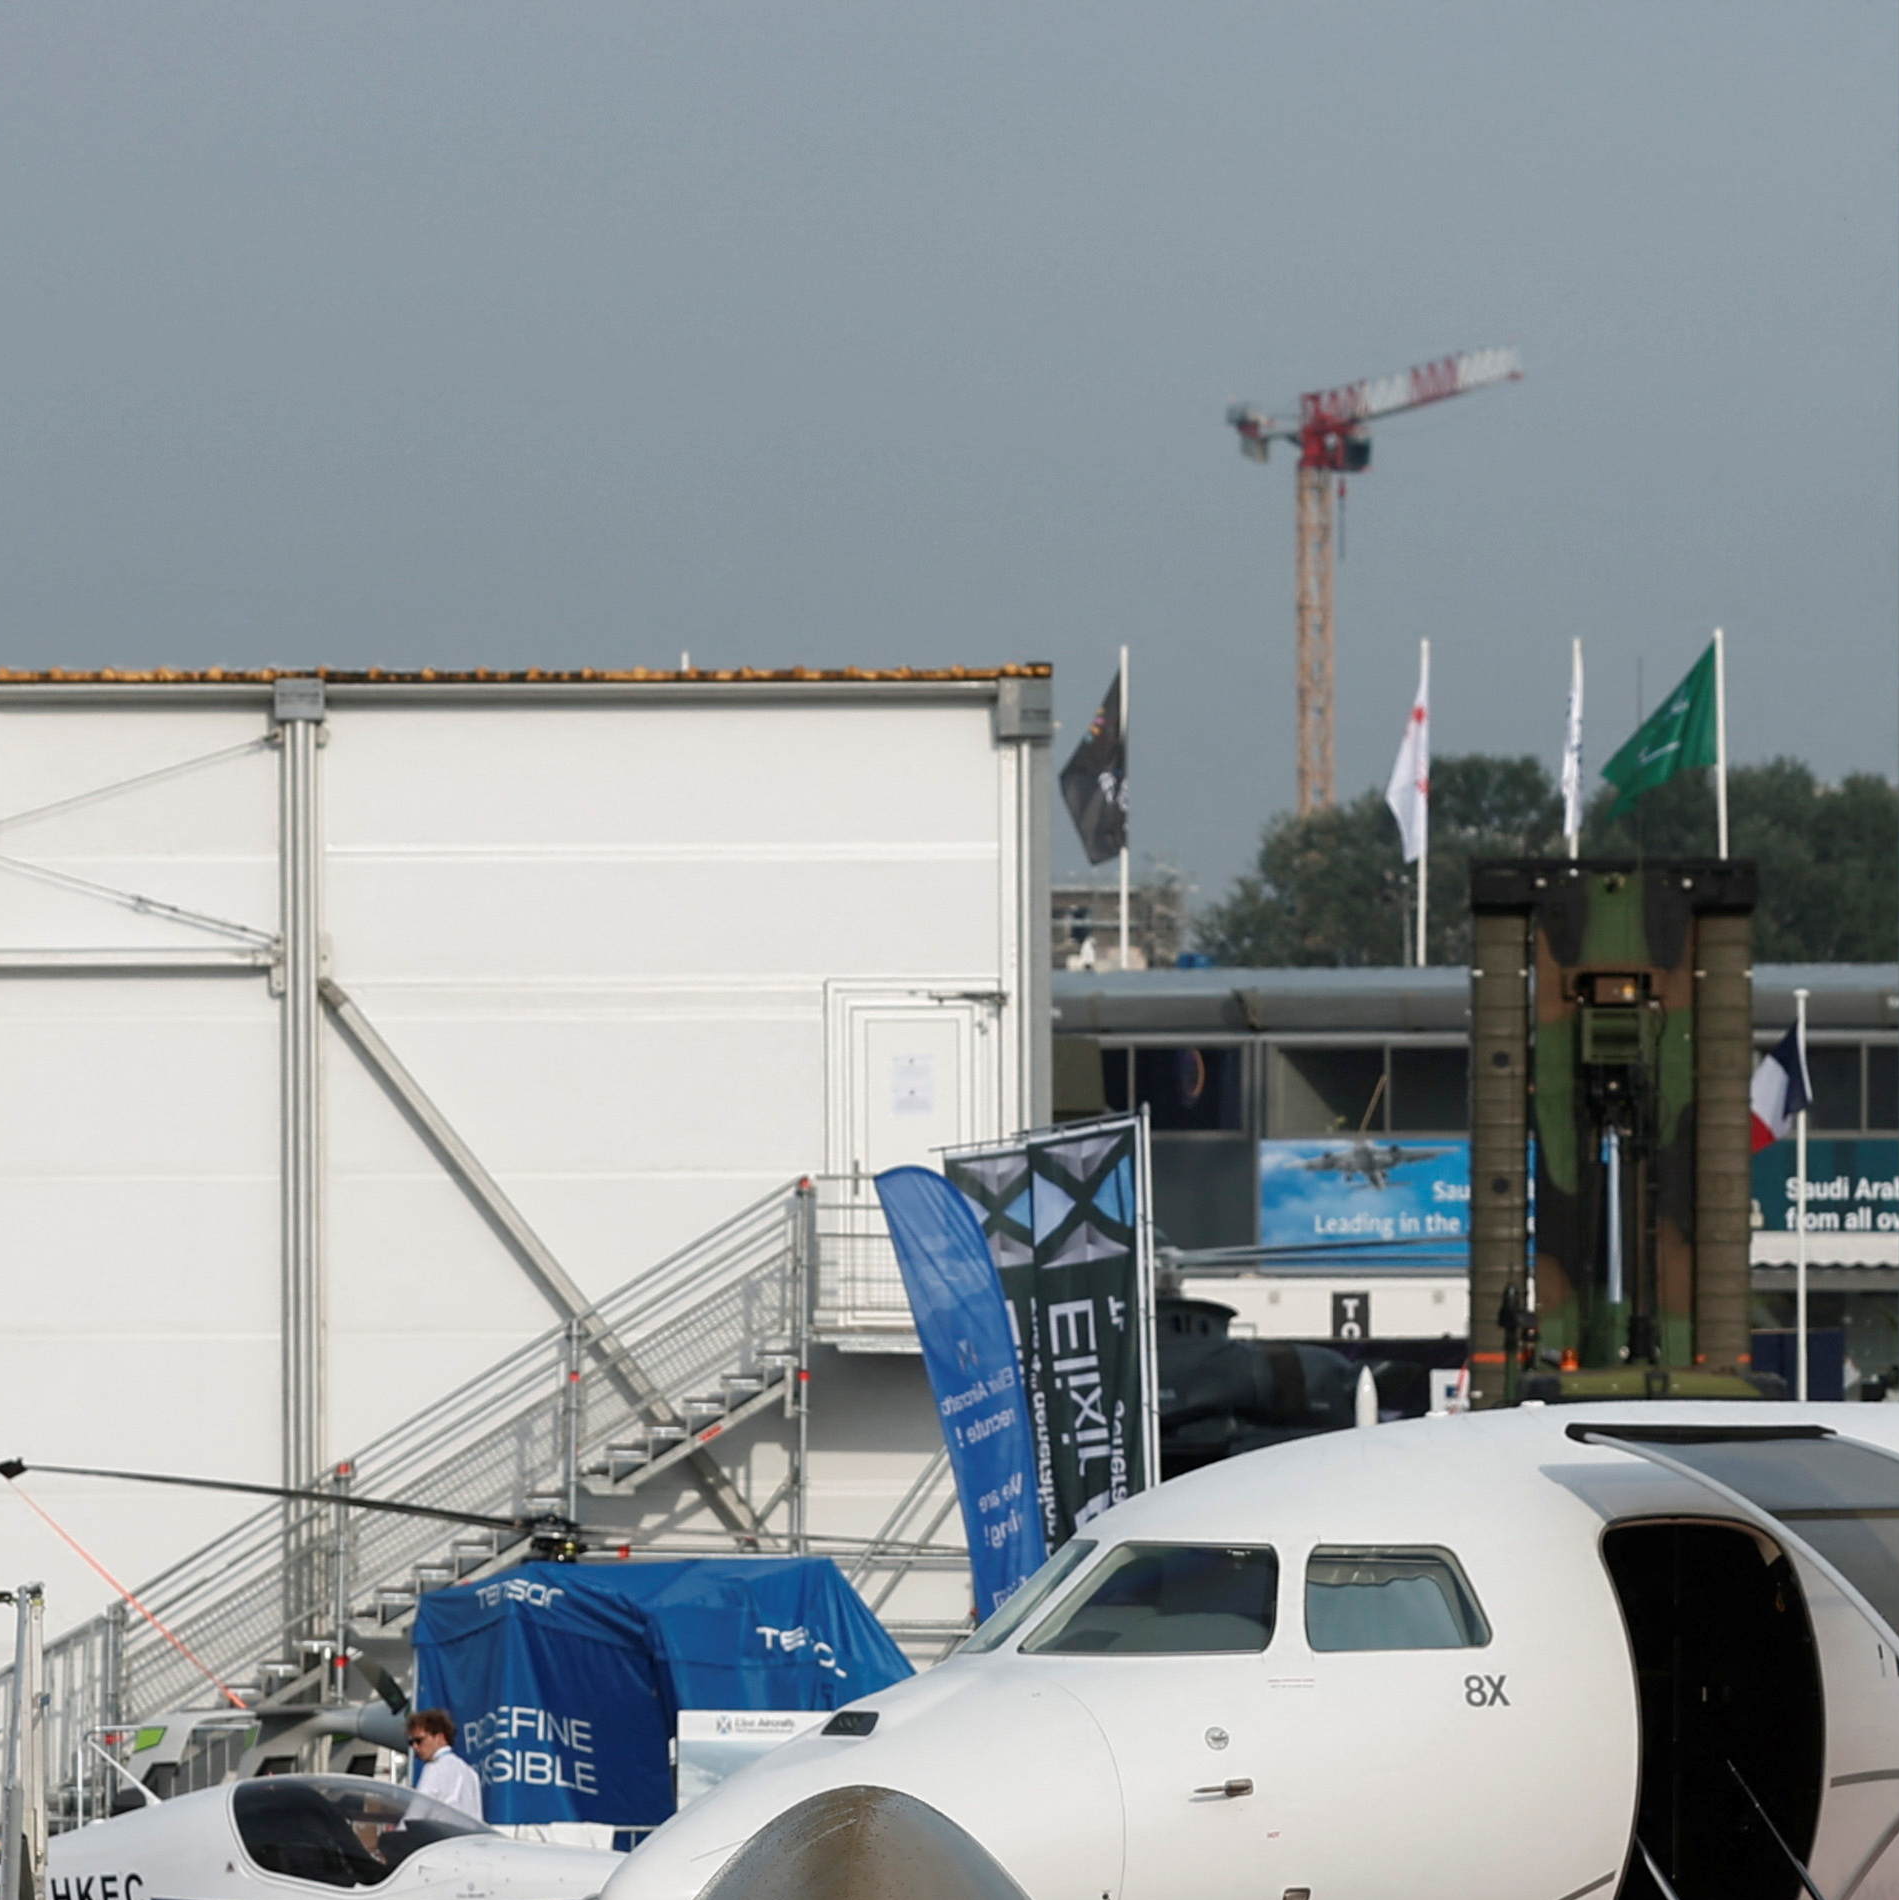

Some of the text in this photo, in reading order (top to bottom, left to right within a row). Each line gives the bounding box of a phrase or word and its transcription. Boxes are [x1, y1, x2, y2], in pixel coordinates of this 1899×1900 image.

[1785, 1177, 1850, 1200] Saudi
[1314, 1212, 1460, 1239] Leading in the
[1785, 1207, 1840, 1230] fom
[1844, 1207, 1872, 1230] all
[1464, 1674, 1511, 1707] 8X
